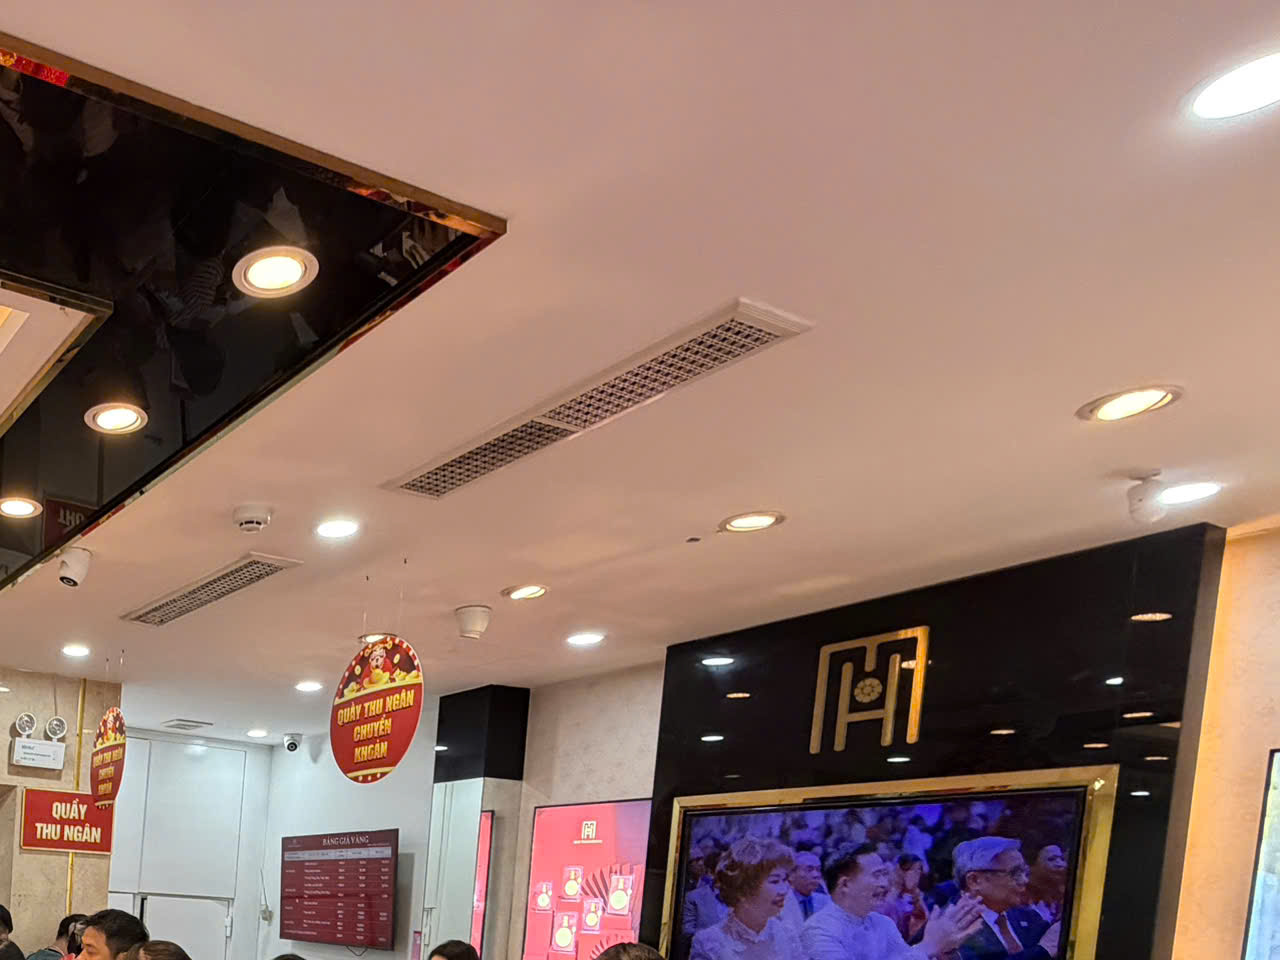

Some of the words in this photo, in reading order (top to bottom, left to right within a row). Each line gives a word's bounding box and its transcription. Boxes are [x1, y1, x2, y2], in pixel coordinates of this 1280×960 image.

[337, 702, 361, 726] QUẦY
[364, 698, 383, 718] THU
[386, 689, 415, 711] NGÂN
[52, 798, 87, 820] QUẦY
[35, 822, 61, 840] THU
[64, 823, 101, 843] NGÂN
